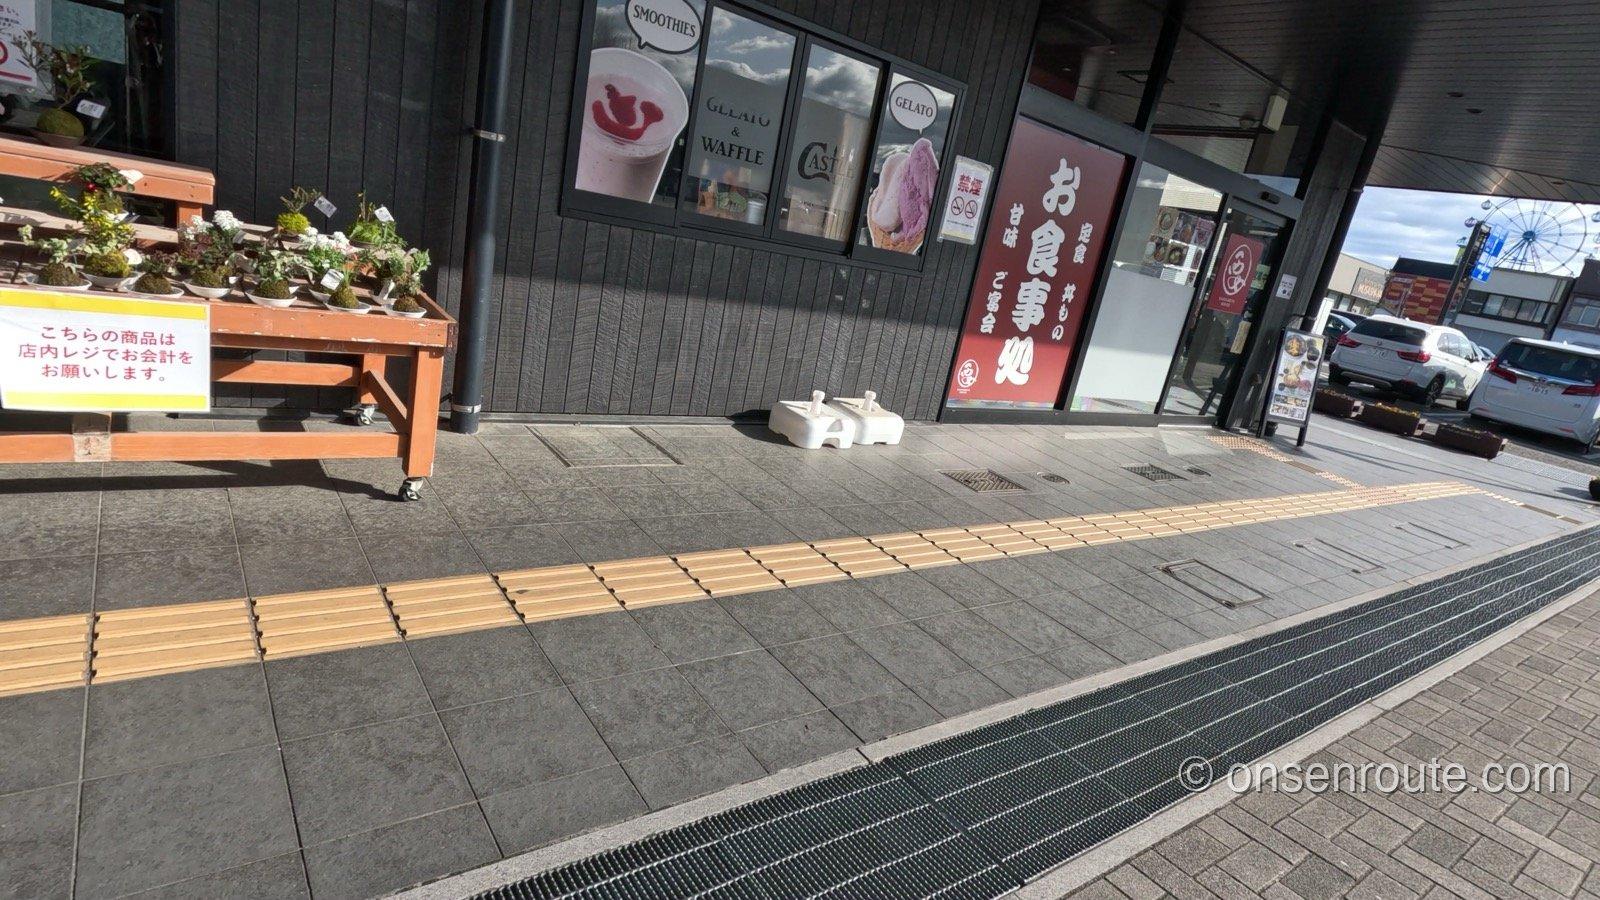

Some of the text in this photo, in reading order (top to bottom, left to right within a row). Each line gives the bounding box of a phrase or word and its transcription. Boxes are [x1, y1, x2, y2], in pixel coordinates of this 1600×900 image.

[633, 4, 697, 38] SMOOTHIES
[895, 96, 933, 119] GELATO
[731, 126, 740, 137] &
[701, 136, 764, 166] WAFFLE
[957, 172, 983, 196] 禁煙
[1002, 203, 1025, 249] 甘味
[1073, 222, 1094, 264] 定食
[994, 157, 1082, 386] お食事処
[980, 271, 1009, 334] ご宴会
[1051, 283, 1077, 341] 丼もの
[40, 326, 176, 346] こちらの商品は
[18, 343, 194, 365] 店内レジでお会計を
[41, 363, 166, 382] お願いします。
